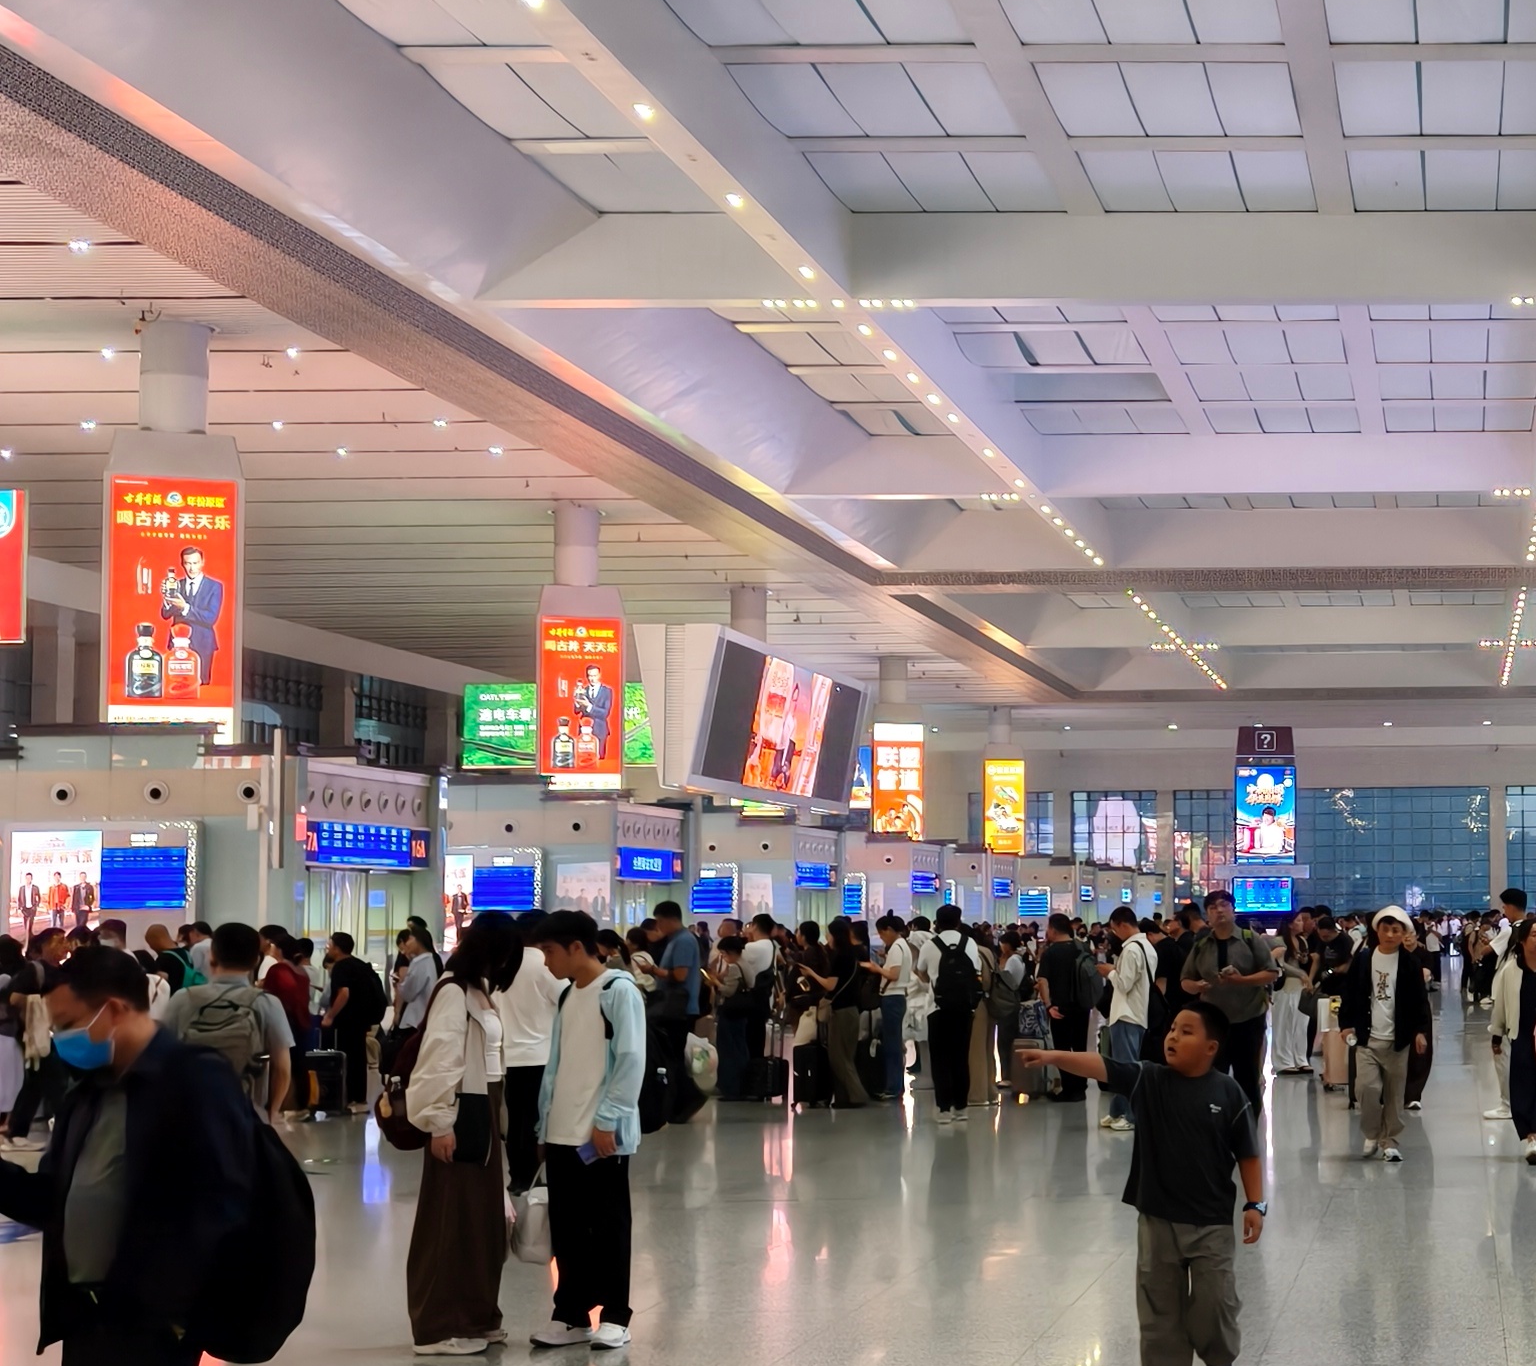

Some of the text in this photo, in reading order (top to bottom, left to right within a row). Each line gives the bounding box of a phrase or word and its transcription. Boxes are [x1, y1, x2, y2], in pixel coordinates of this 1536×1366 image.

[116, 510, 231, 530] 喝古井 天天乐
